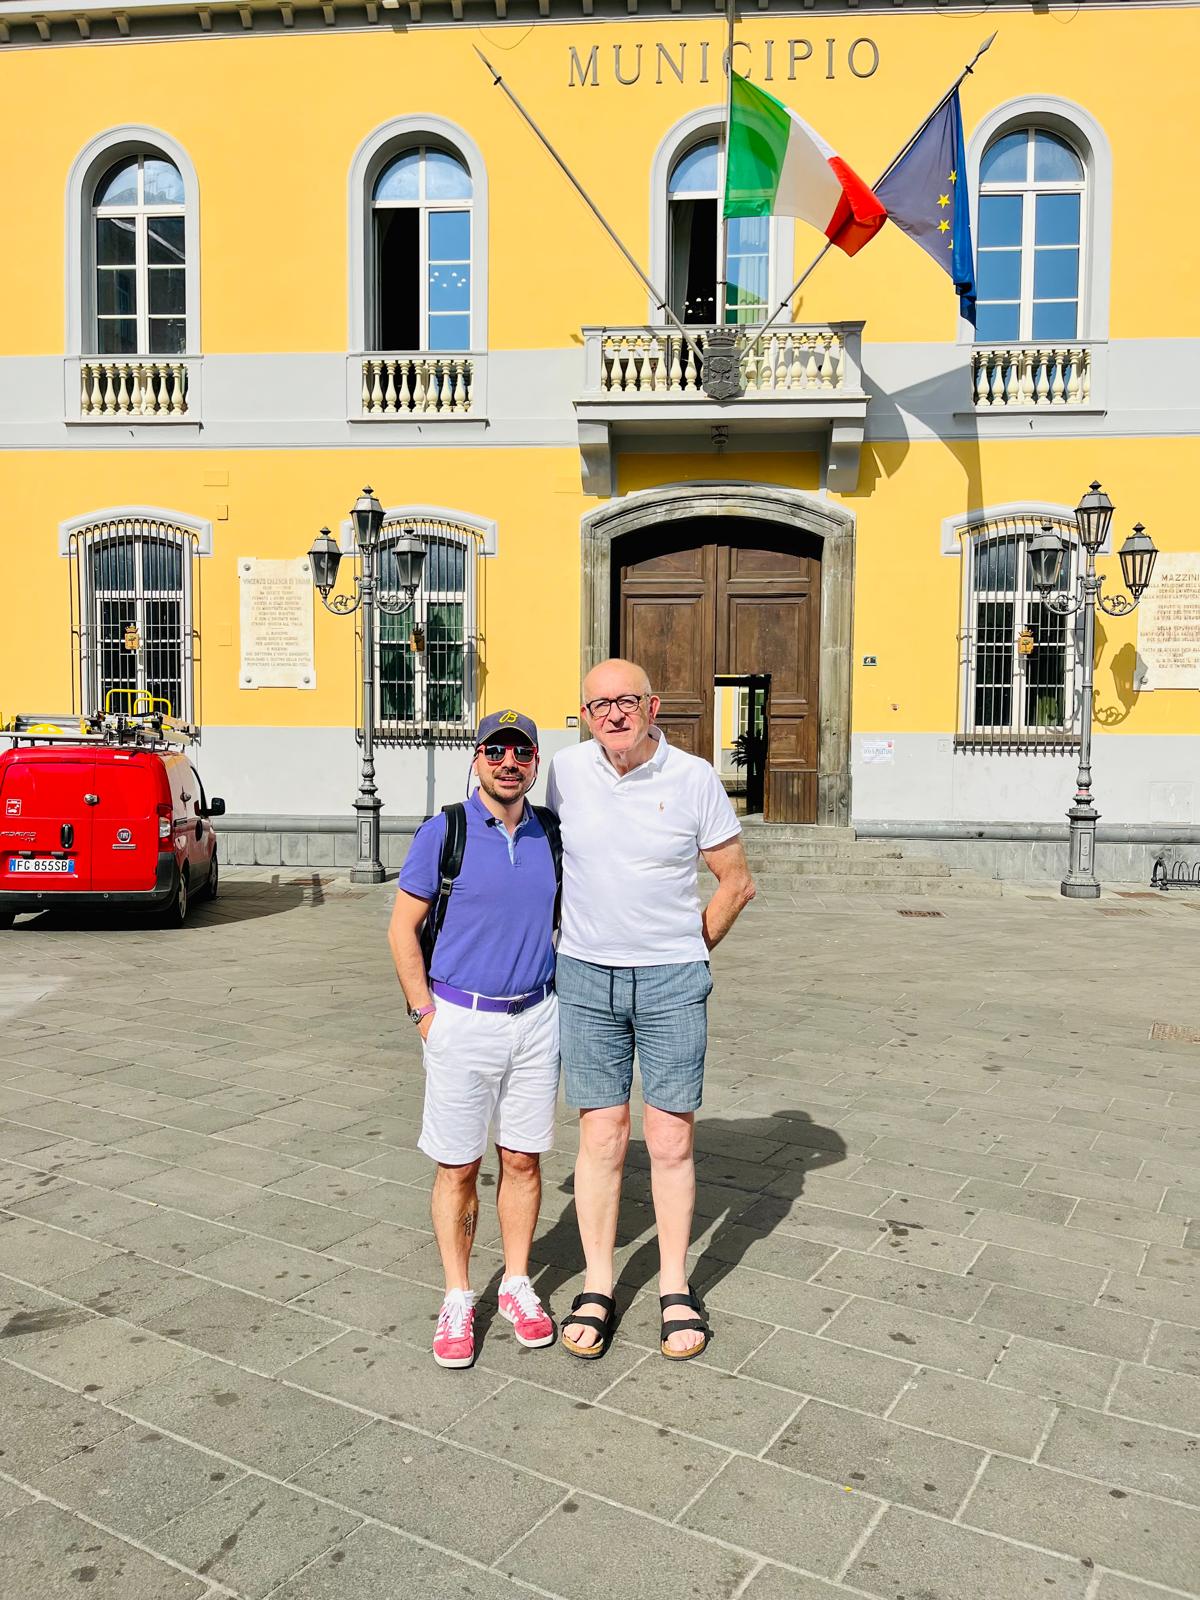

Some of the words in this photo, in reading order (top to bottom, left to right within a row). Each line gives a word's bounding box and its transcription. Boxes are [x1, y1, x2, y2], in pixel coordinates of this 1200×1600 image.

[568, 37, 880, 87] MUNICIPIO
[17, 860, 30, 871] FG
[34, 860, 67, 871] 855SB
